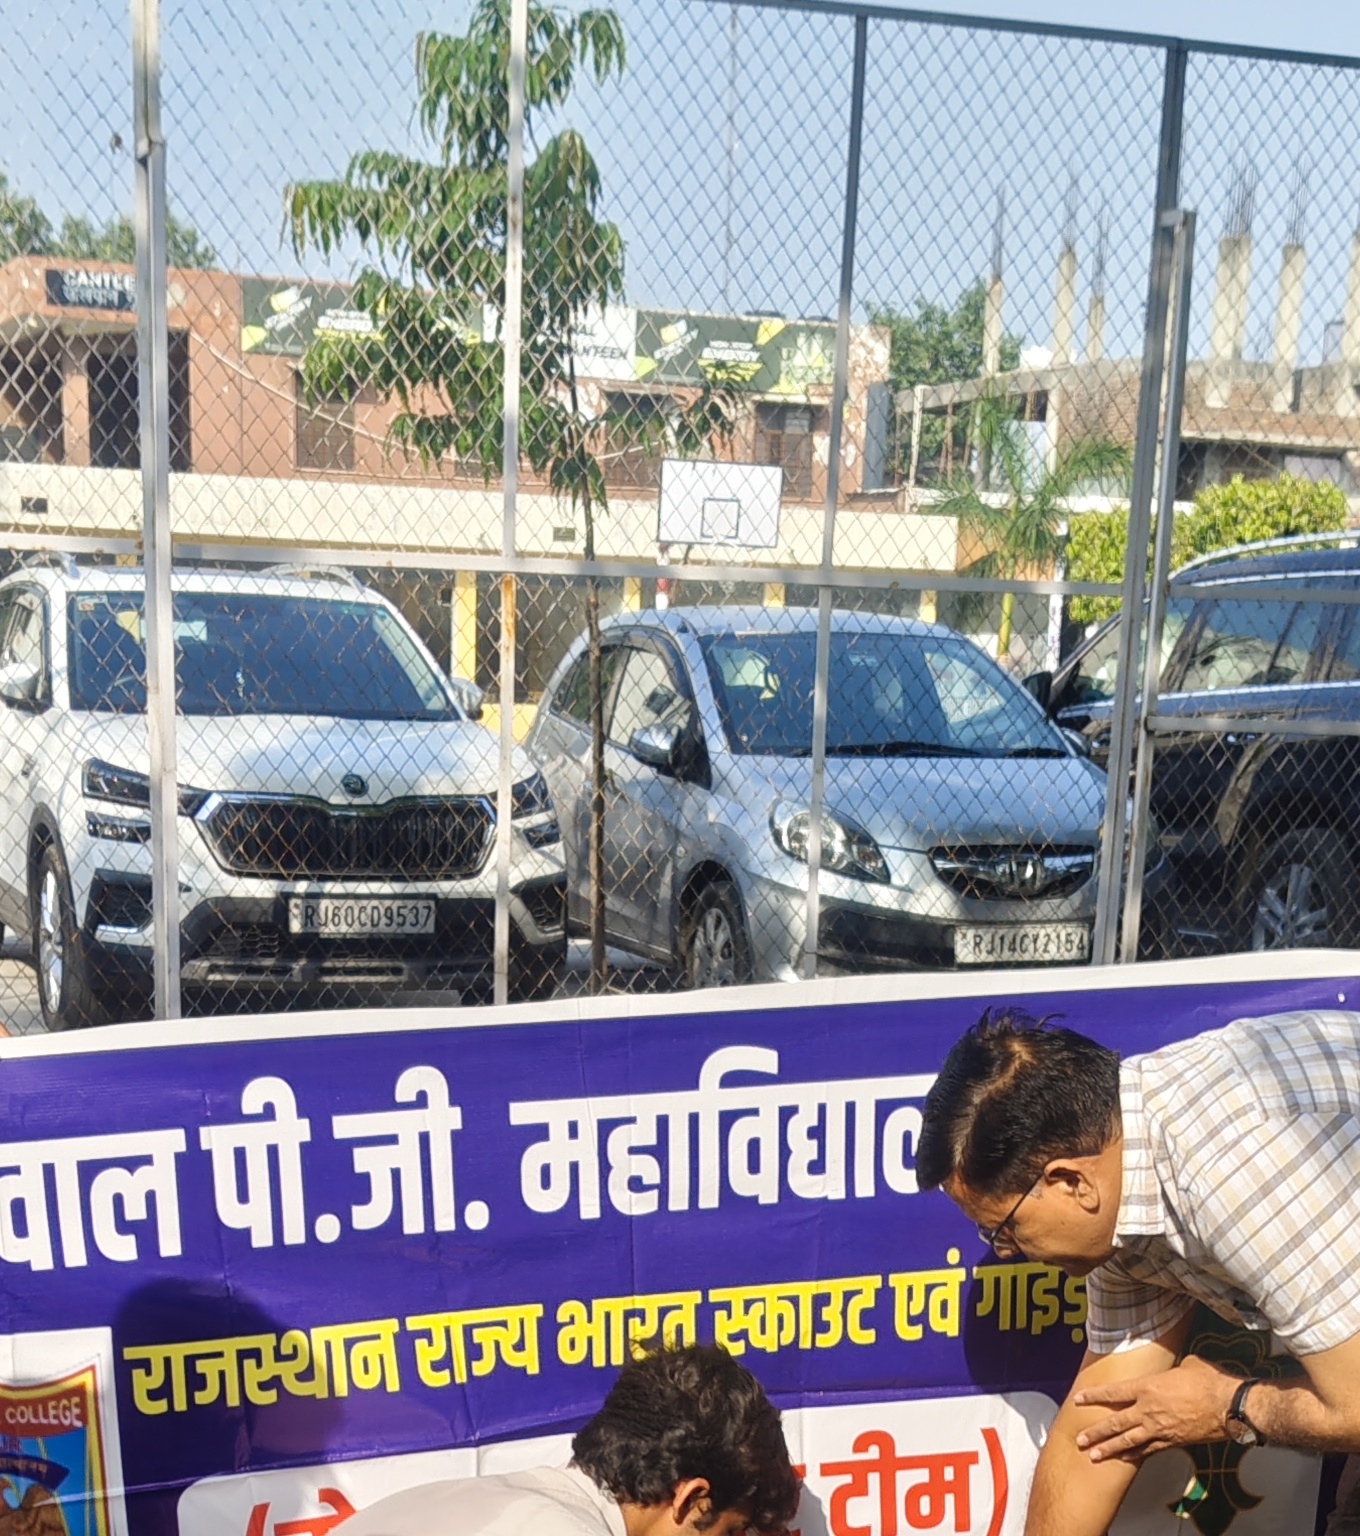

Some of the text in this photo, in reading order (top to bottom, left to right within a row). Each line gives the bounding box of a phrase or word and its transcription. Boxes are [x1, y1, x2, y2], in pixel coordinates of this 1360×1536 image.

[62, 268, 137, 291] CANTEE
[303, 904, 433, 928] RJ60CD9537
[200, 1064, 490, 1250] पी.जी.
[509, 1045, 939, 1221] महाविद्याल
[123, 1317, 400, 1415] राजस्थान
[406, 1303, 544, 1386] राज्य
[557, 1290, 702, 1368] भारत
[708, 1274, 882, 1357] स्काउट
[889, 1247, 967, 1342] एवं
[5, 1396, 83, 1428] COLLEGE
